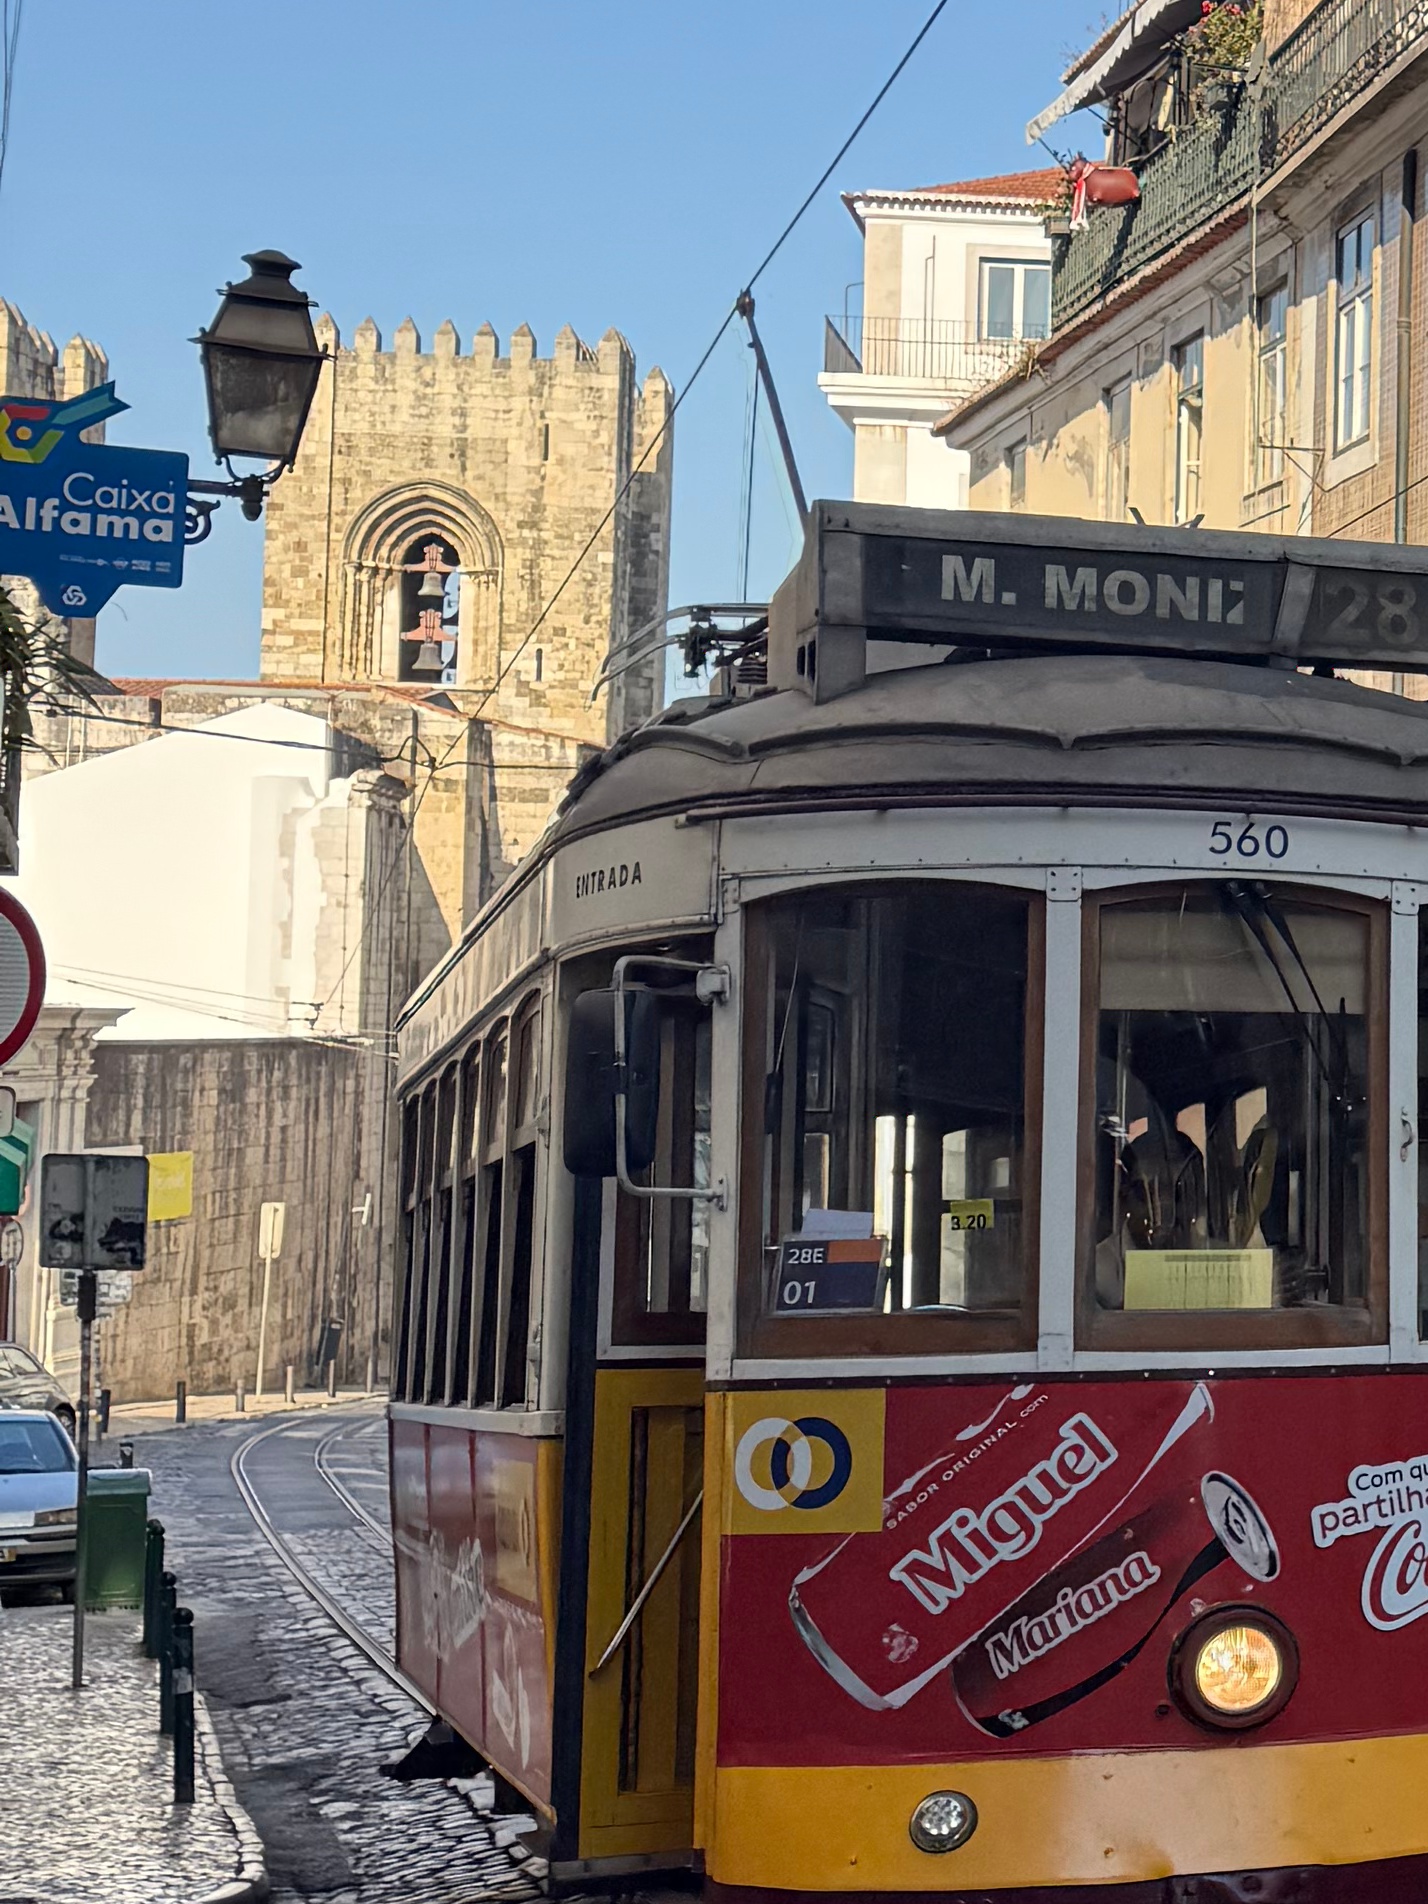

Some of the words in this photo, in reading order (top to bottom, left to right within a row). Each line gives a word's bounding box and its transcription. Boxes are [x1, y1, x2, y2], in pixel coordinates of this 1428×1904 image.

[63, 472, 175, 514] Caixa
[0, 494, 174, 543] Alfama
[941, 554, 1017, 606] M.
[1326, 576, 1421, 645] 28
[1208, 820, 1289, 859] 560
[575, 860, 642, 899] ENTRADA
[787, 1248, 825, 1265] 28E
[782, 1280, 816, 1305] 01
[885, 1482, 939, 1531] SABOR
[941, 1420, 1018, 1482] ORIGINAL
[1355, 1469, 1404, 1491] Com
[892, 1413, 1117, 1613] Miguel
[986, 1552, 1161, 1678] Mariana
